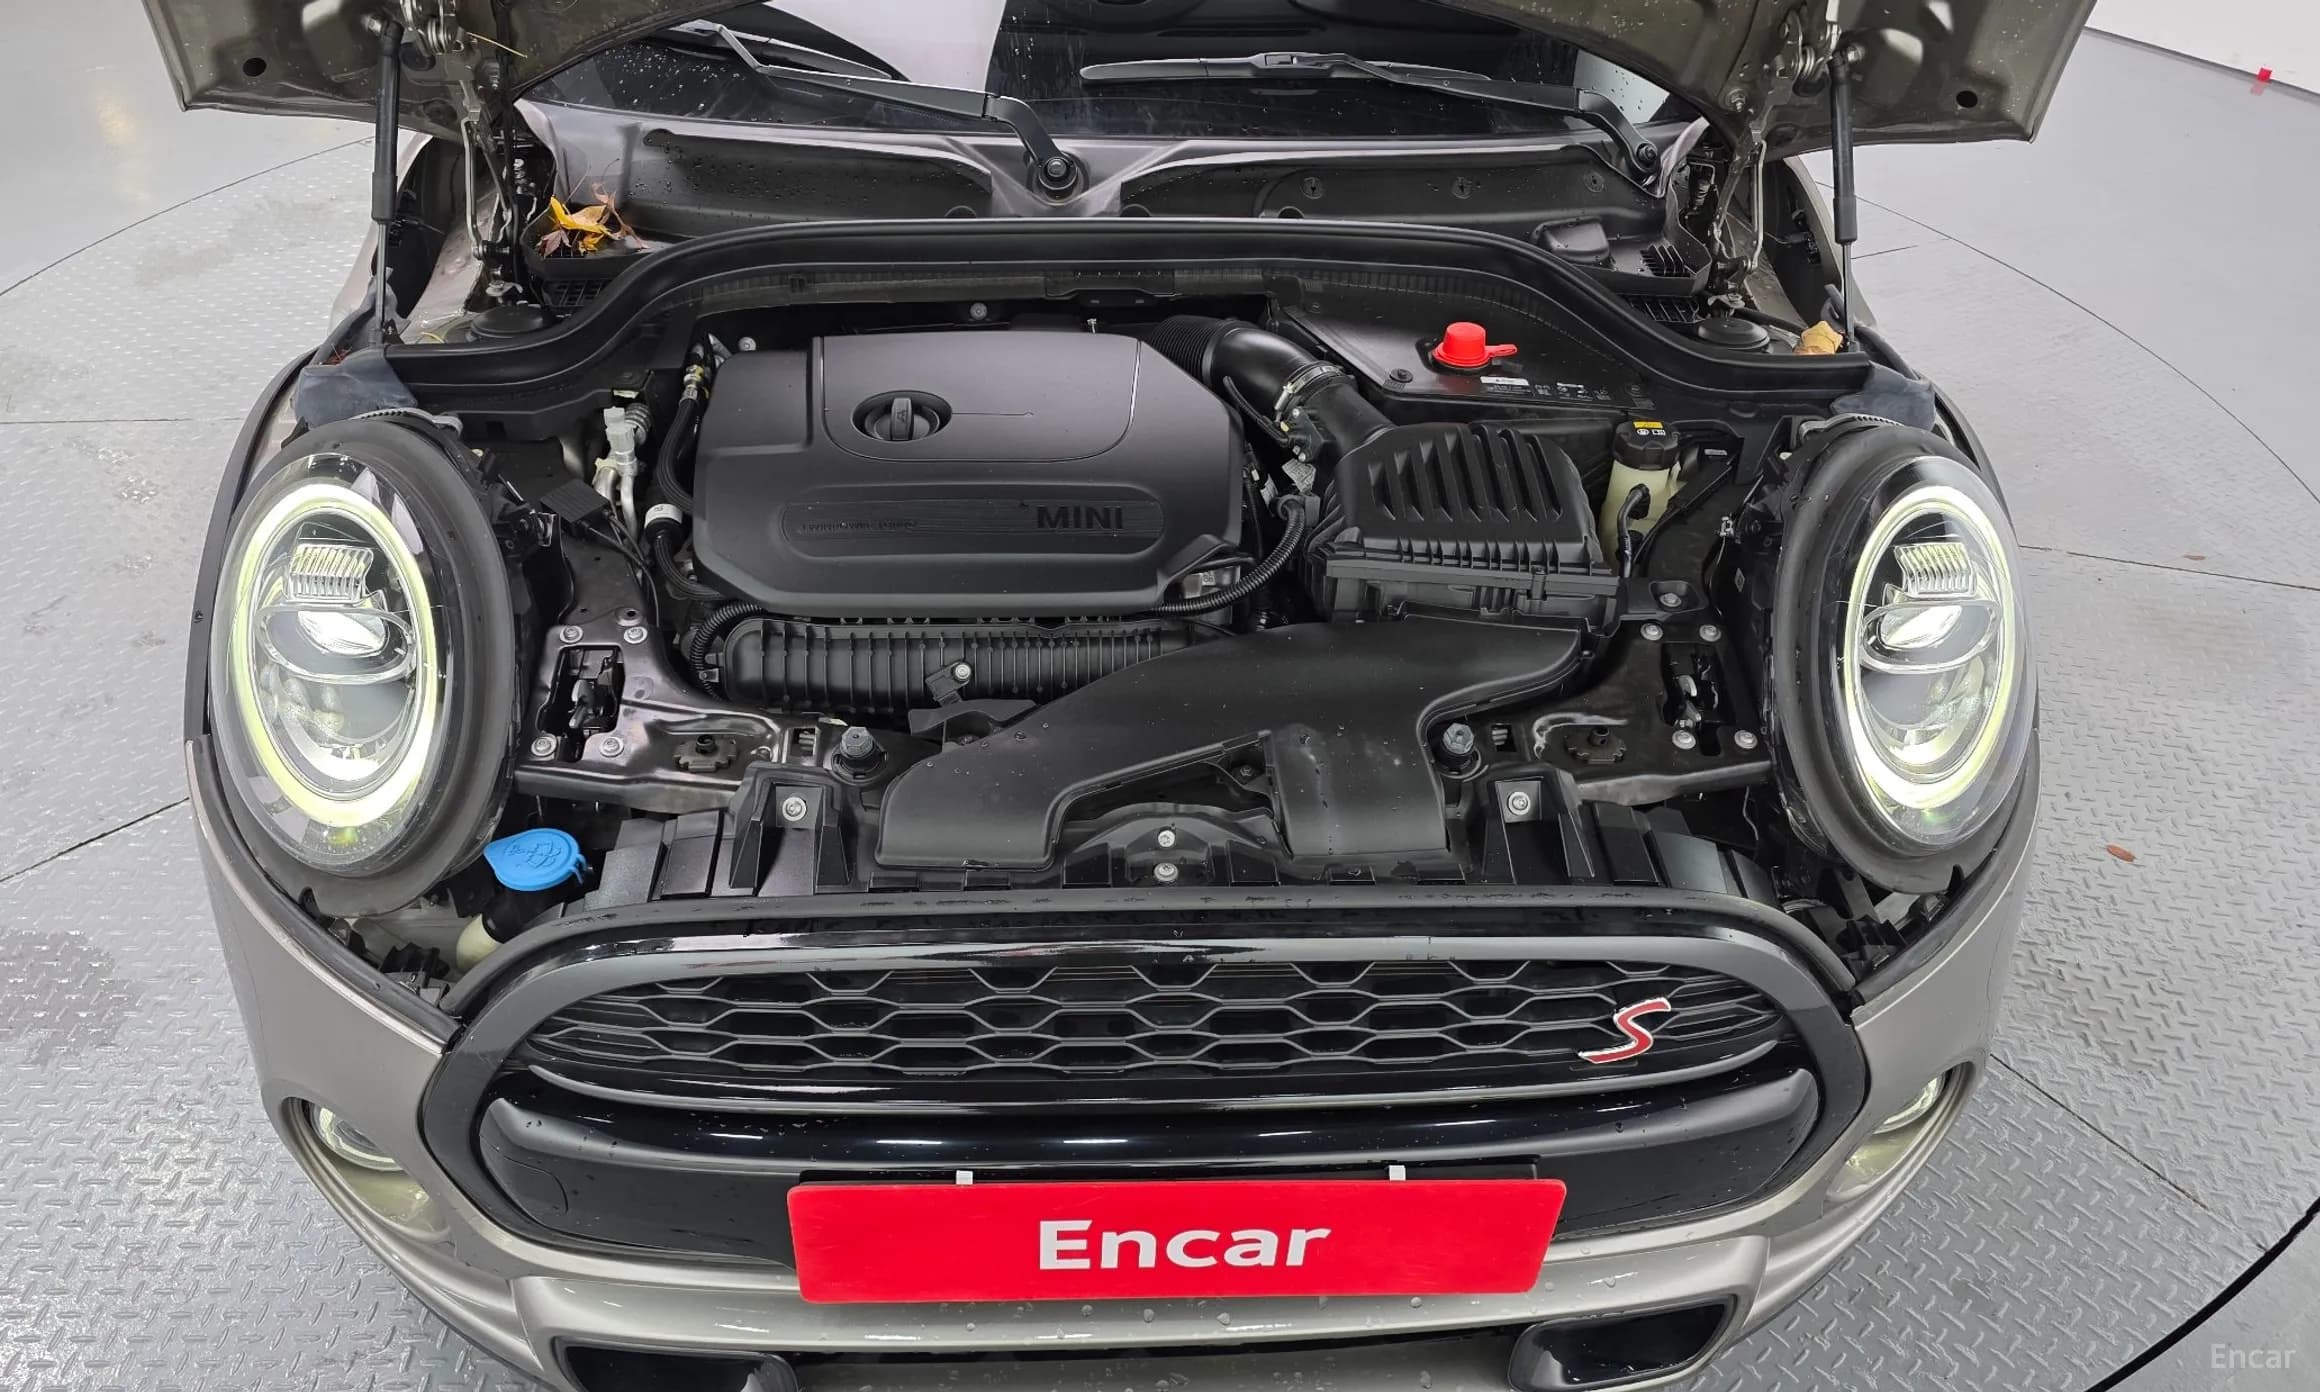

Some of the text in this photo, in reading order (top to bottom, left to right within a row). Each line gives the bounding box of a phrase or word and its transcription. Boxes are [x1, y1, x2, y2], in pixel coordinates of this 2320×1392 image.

[1036, 505, 1123, 529] MINI
[1578, 997, 1671, 1064] S
[1039, 1219, 1331, 1270] Encar
